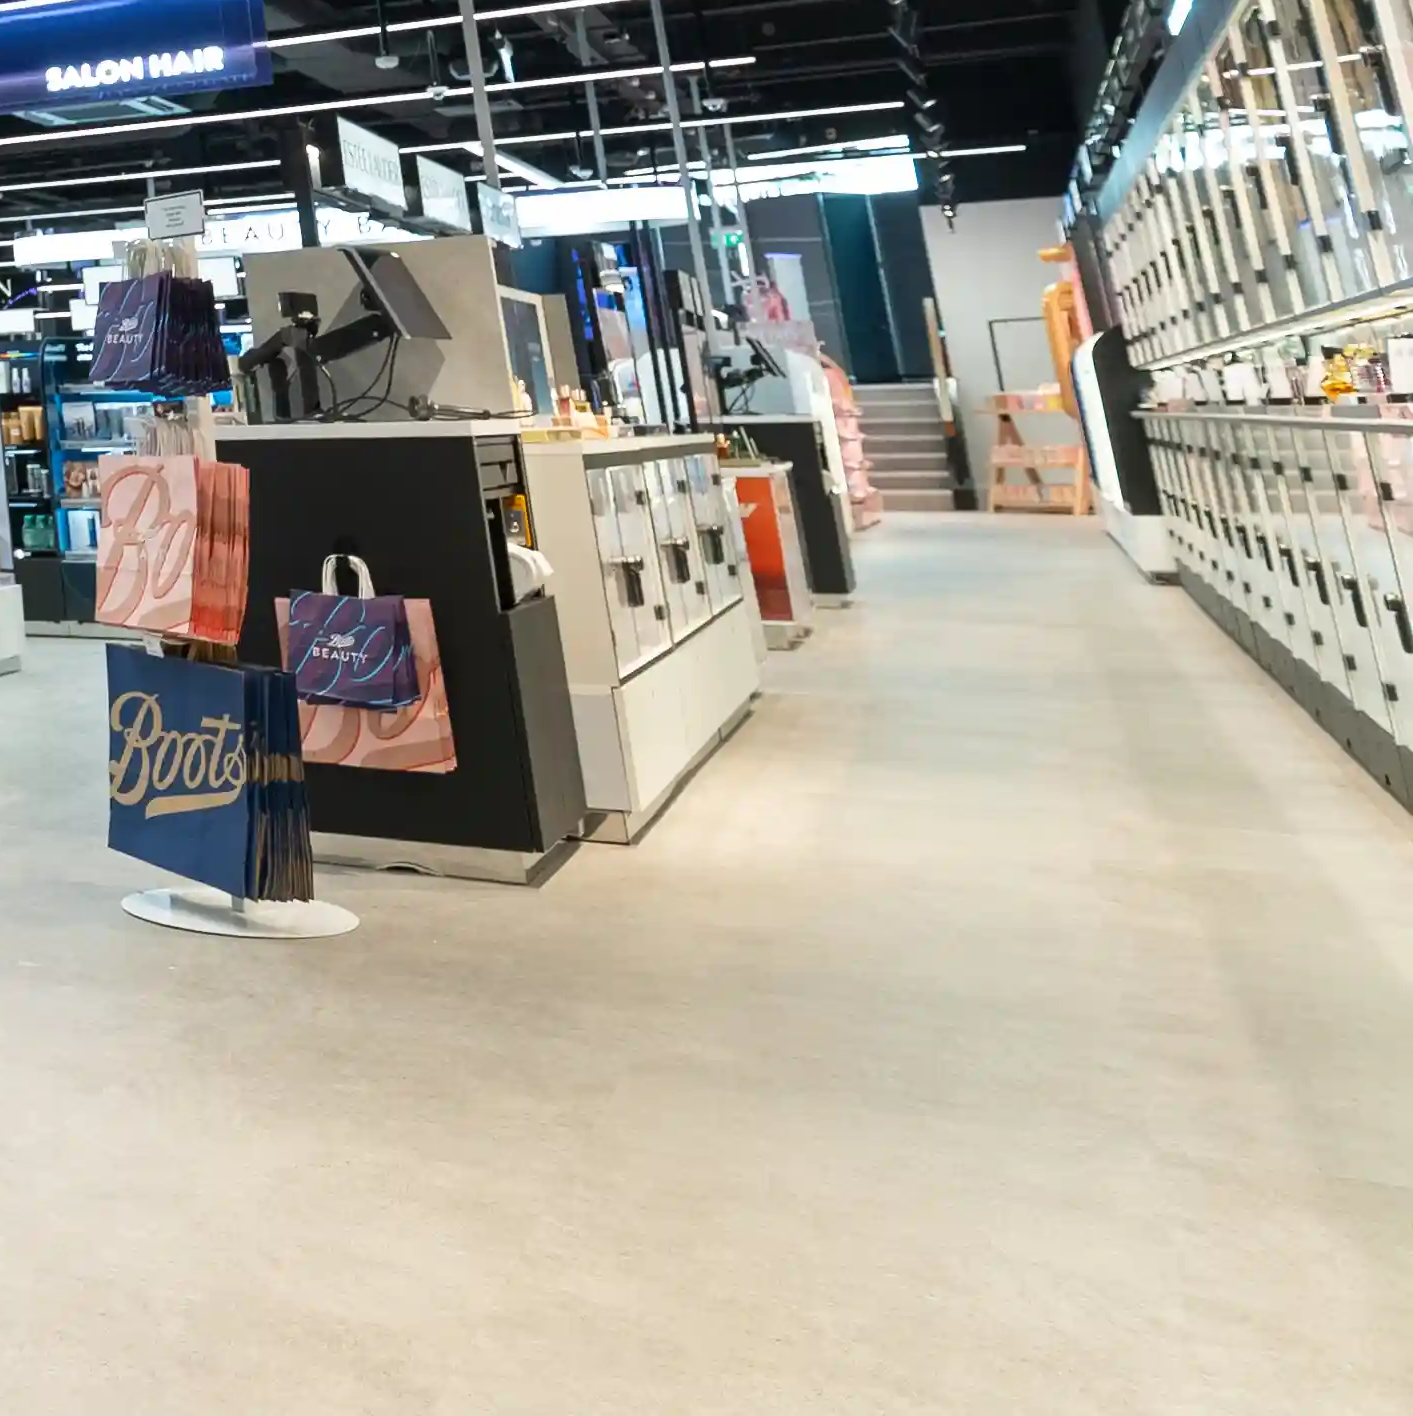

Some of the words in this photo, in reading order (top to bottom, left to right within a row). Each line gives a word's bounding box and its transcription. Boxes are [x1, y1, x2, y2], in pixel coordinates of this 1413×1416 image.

[45, 56, 144, 92] SALON
[148, 45, 224, 79] HAIR
[201, 220, 330, 246] BEAUY
[106, 334, 143, 345] BEAUTY
[312, 646, 368, 664] BEAUTY
[109, 691, 246, 819] Boots
